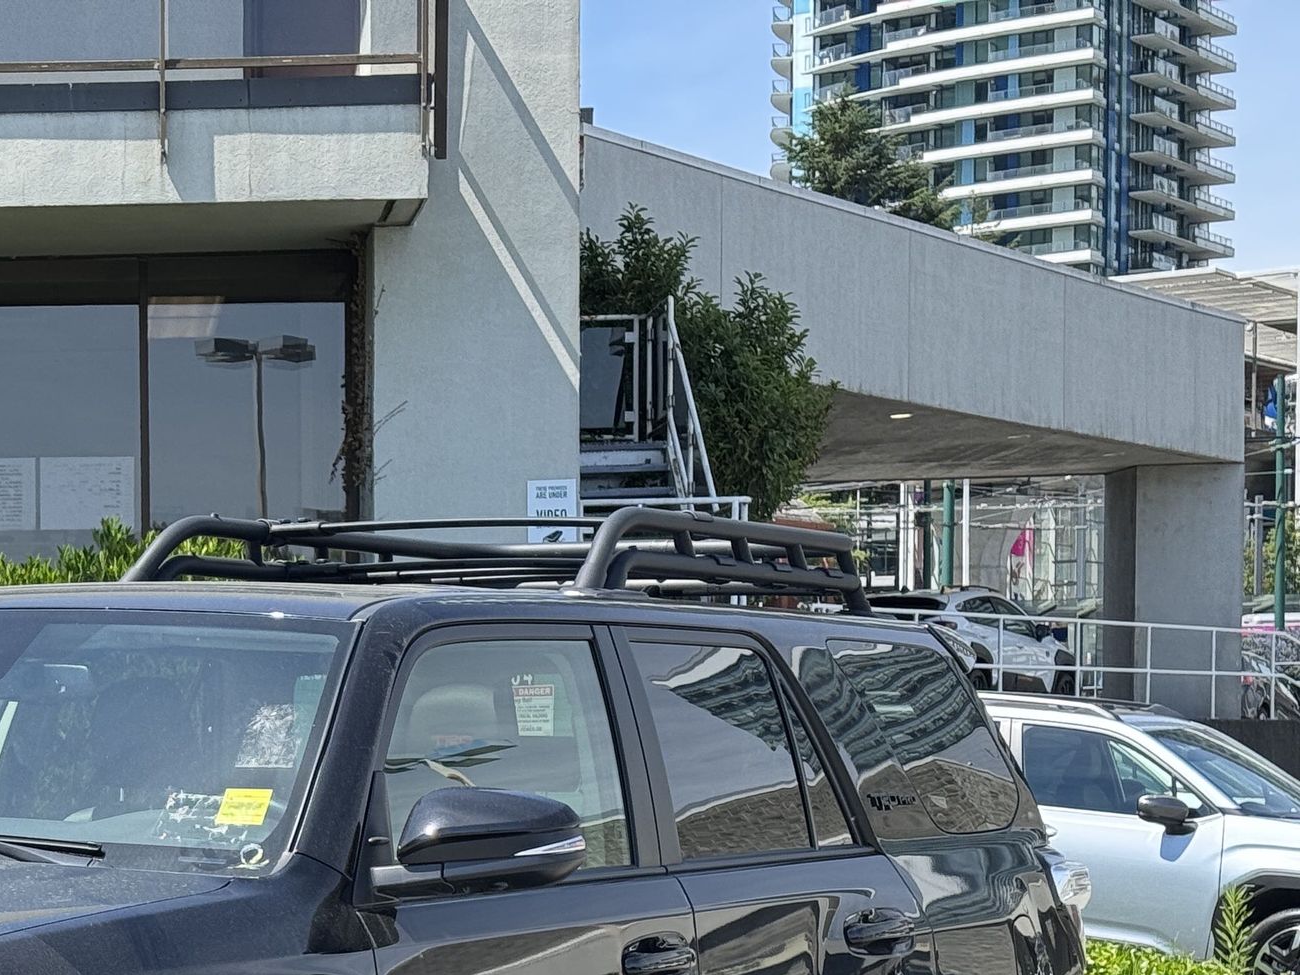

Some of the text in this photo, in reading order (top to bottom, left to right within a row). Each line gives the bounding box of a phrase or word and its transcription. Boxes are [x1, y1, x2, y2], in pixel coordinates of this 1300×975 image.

[535, 491, 568, 499] ARE UNDER
[536, 509, 568, 518] VIDEO
[518, 687, 551, 696] DANGER
